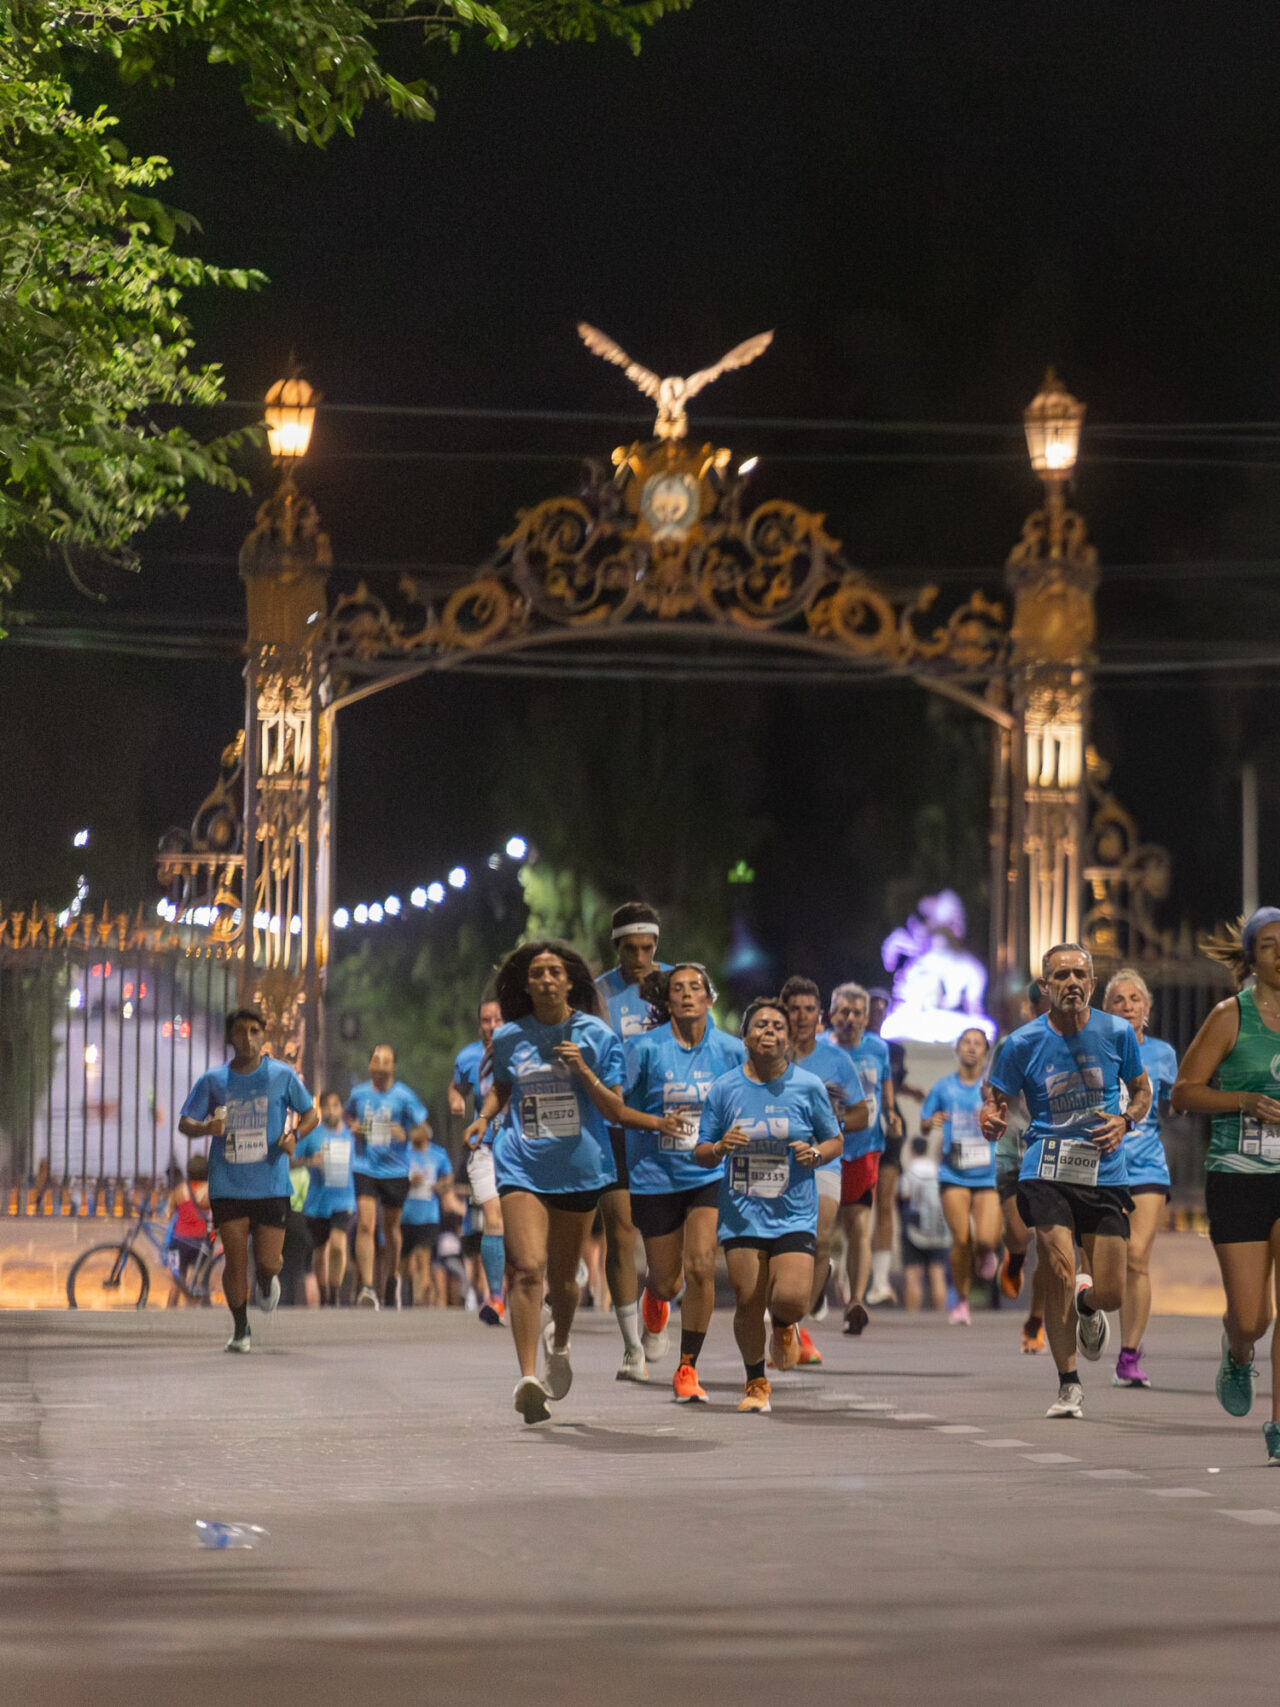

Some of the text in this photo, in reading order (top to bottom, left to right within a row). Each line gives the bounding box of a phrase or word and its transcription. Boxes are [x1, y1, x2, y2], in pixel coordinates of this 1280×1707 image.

[1048, 1140, 1056, 1150] B
[1044, 1154, 1056, 1163] 10K
[1060, 1155, 1097, 1168] B2008
